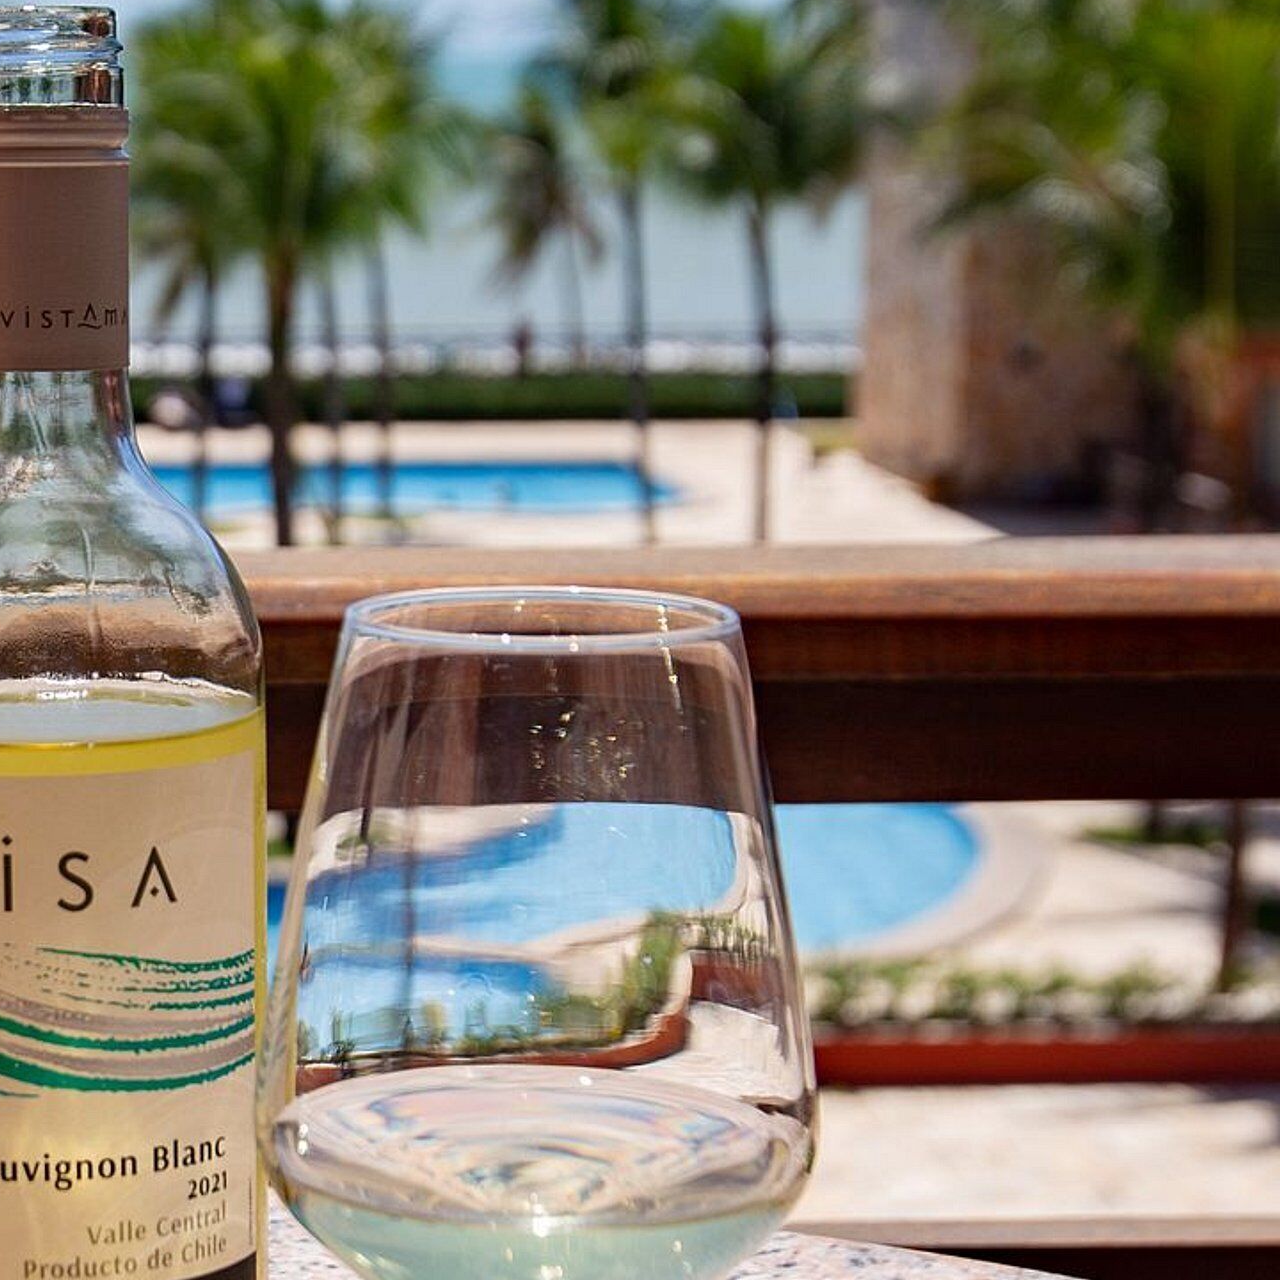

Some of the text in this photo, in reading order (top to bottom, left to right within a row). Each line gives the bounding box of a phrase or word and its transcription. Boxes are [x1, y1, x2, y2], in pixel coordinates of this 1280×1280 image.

[152, 1135, 227, 1173] Blanc
[187, 1170, 228, 1200] 2021
[86, 1219, 147, 1246] Valle
[155, 1199, 227, 1238] Central
[23, 1234, 227, 1280] Producto de Chile
